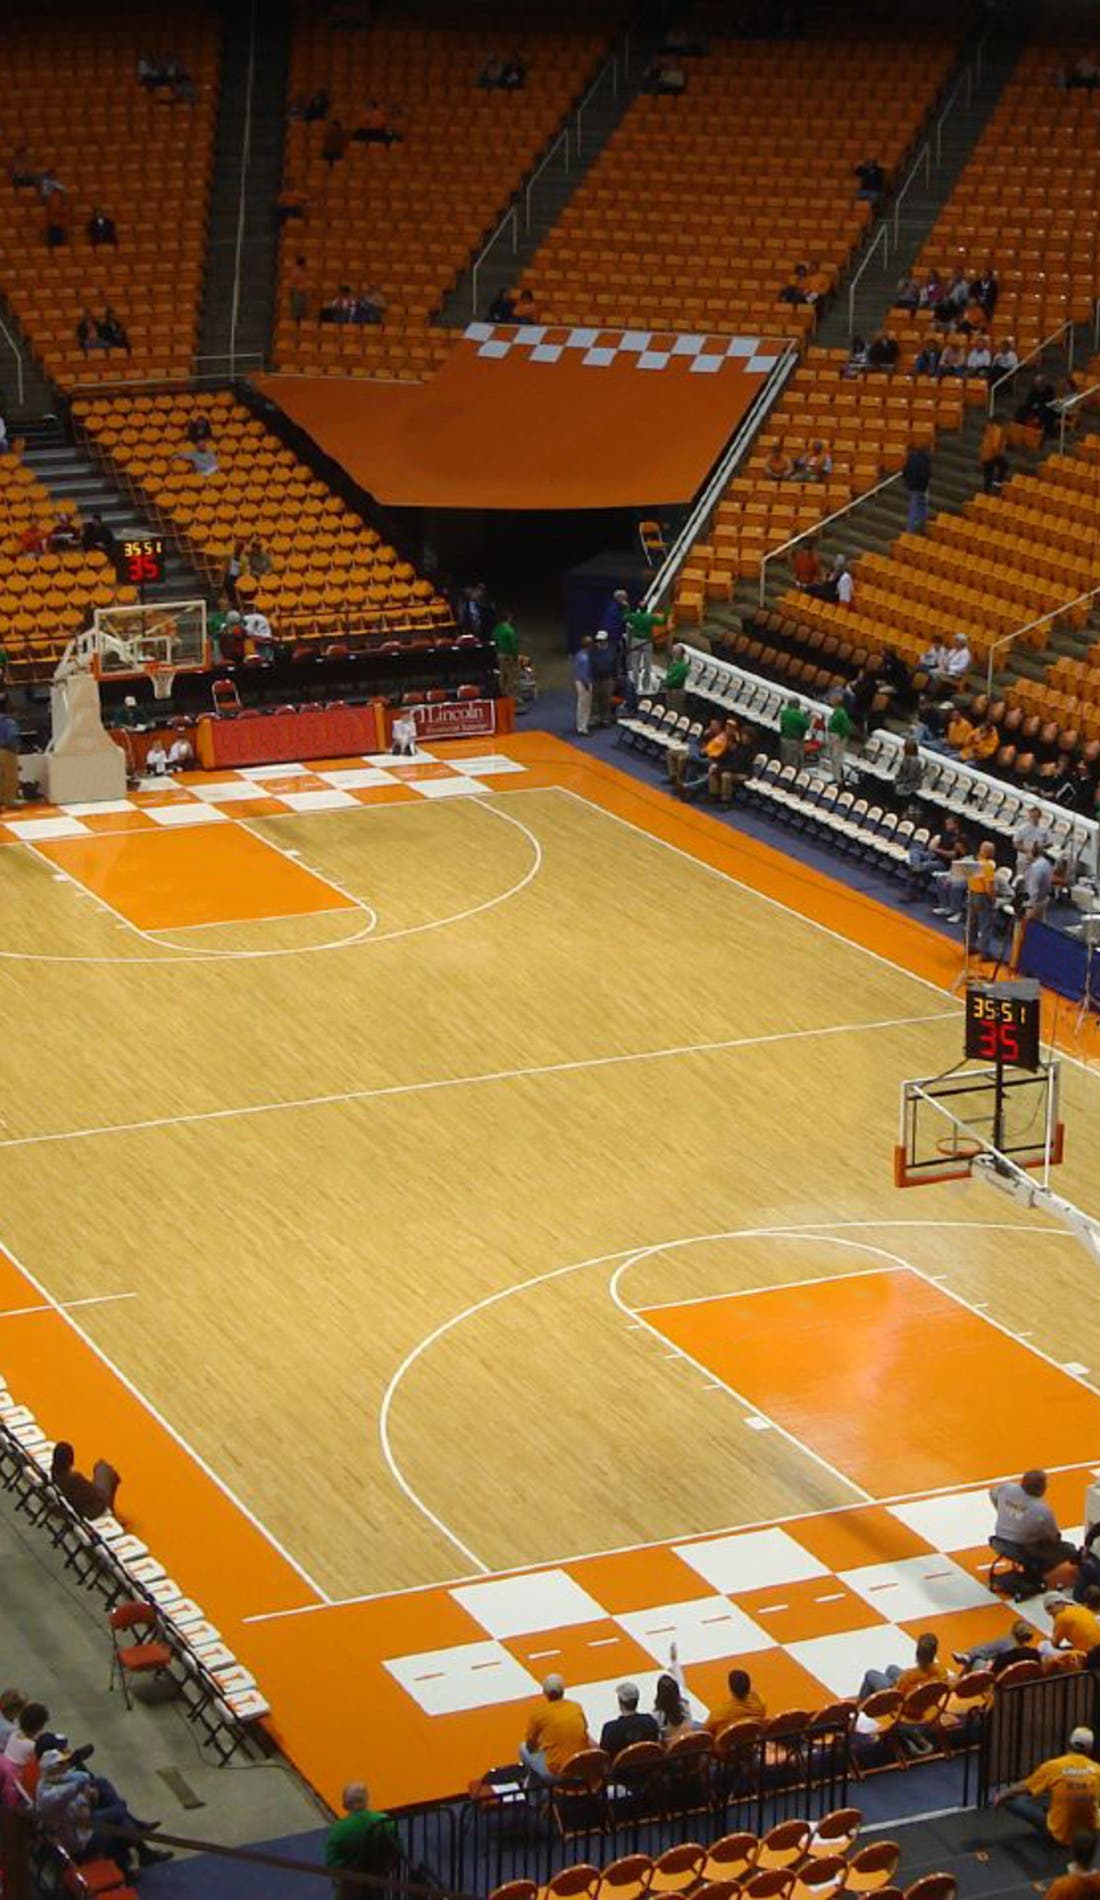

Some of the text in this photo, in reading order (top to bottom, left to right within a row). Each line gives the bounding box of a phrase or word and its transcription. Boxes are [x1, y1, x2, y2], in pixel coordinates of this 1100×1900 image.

[130, 556, 157, 580] 35
[428, 702, 484, 724] Lincoln
[980, 1019, 1019, 1061] 35
